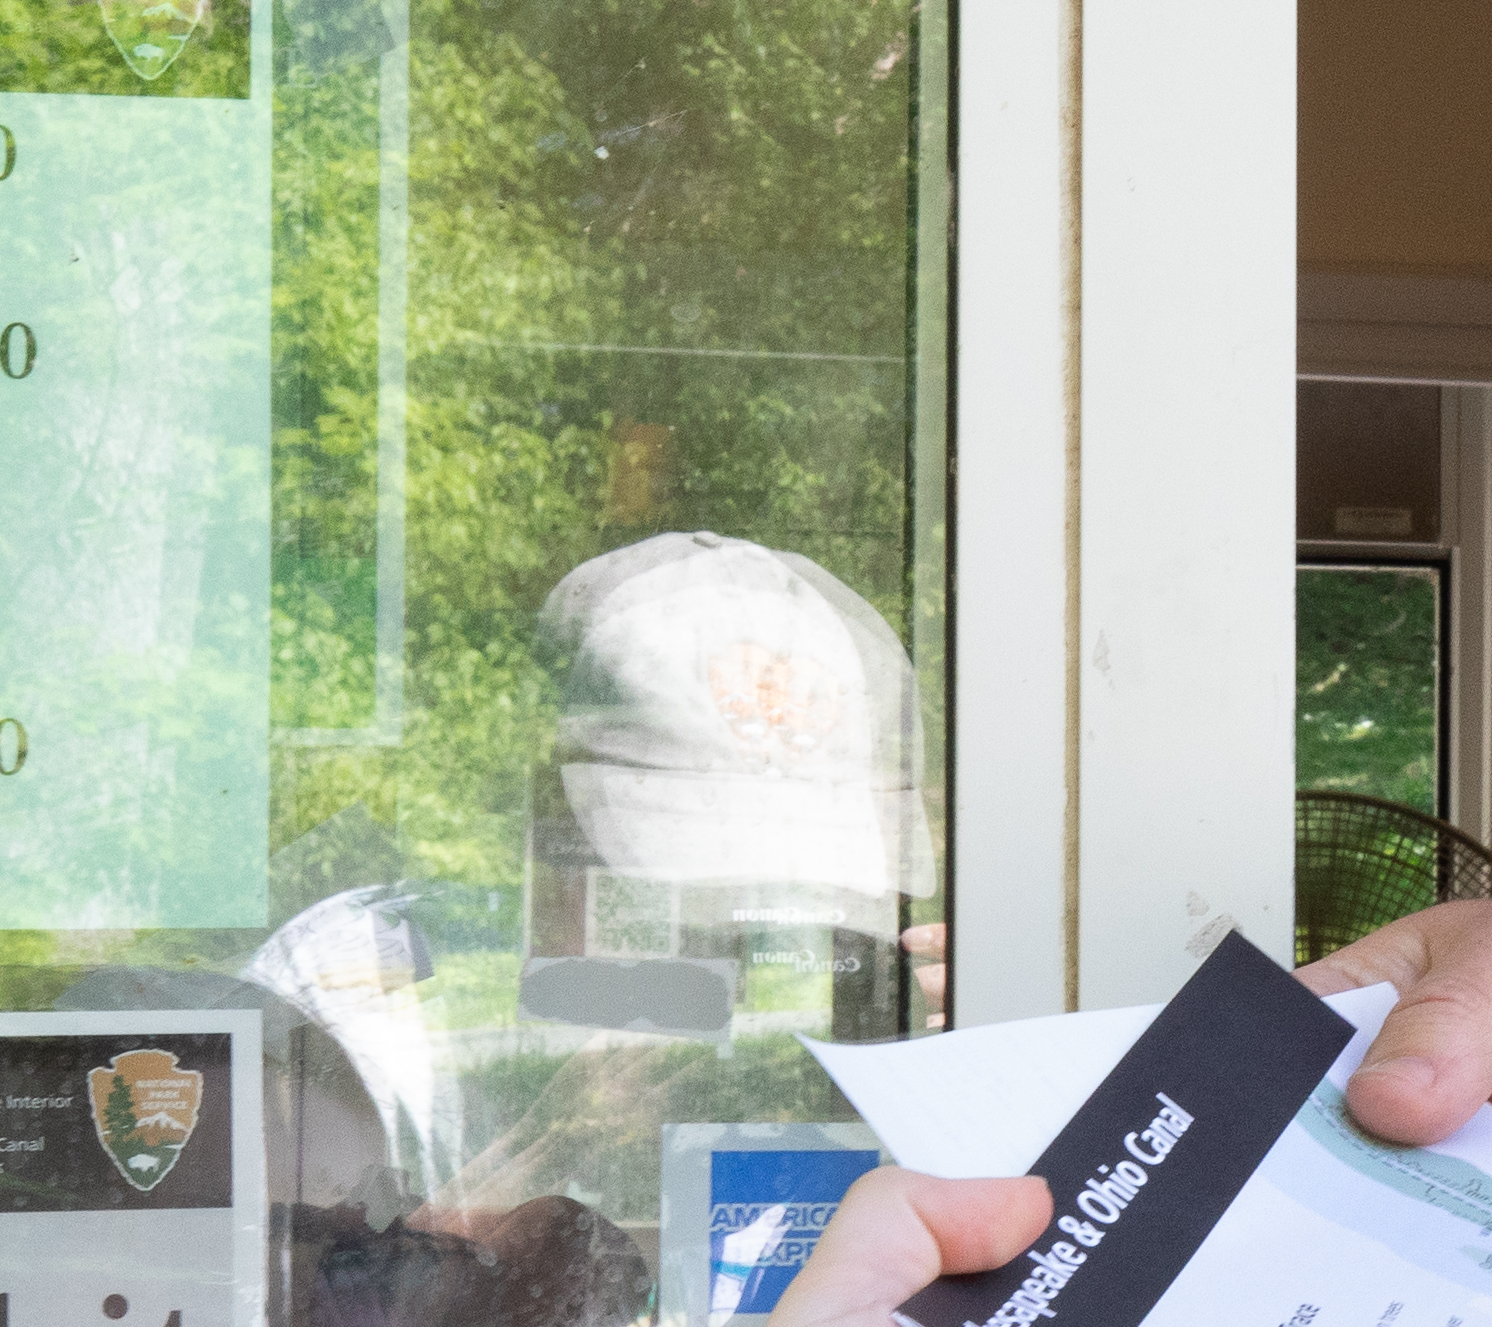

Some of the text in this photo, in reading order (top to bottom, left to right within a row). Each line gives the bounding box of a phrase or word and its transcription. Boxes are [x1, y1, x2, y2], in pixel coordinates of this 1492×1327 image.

[7, 1093, 74, 1110] Interior
[1124, 1091, 1195, 1166] Canal
[1077, 1160, 1148, 1224] Ohio
[1058, 1215, 1106, 1248] &
